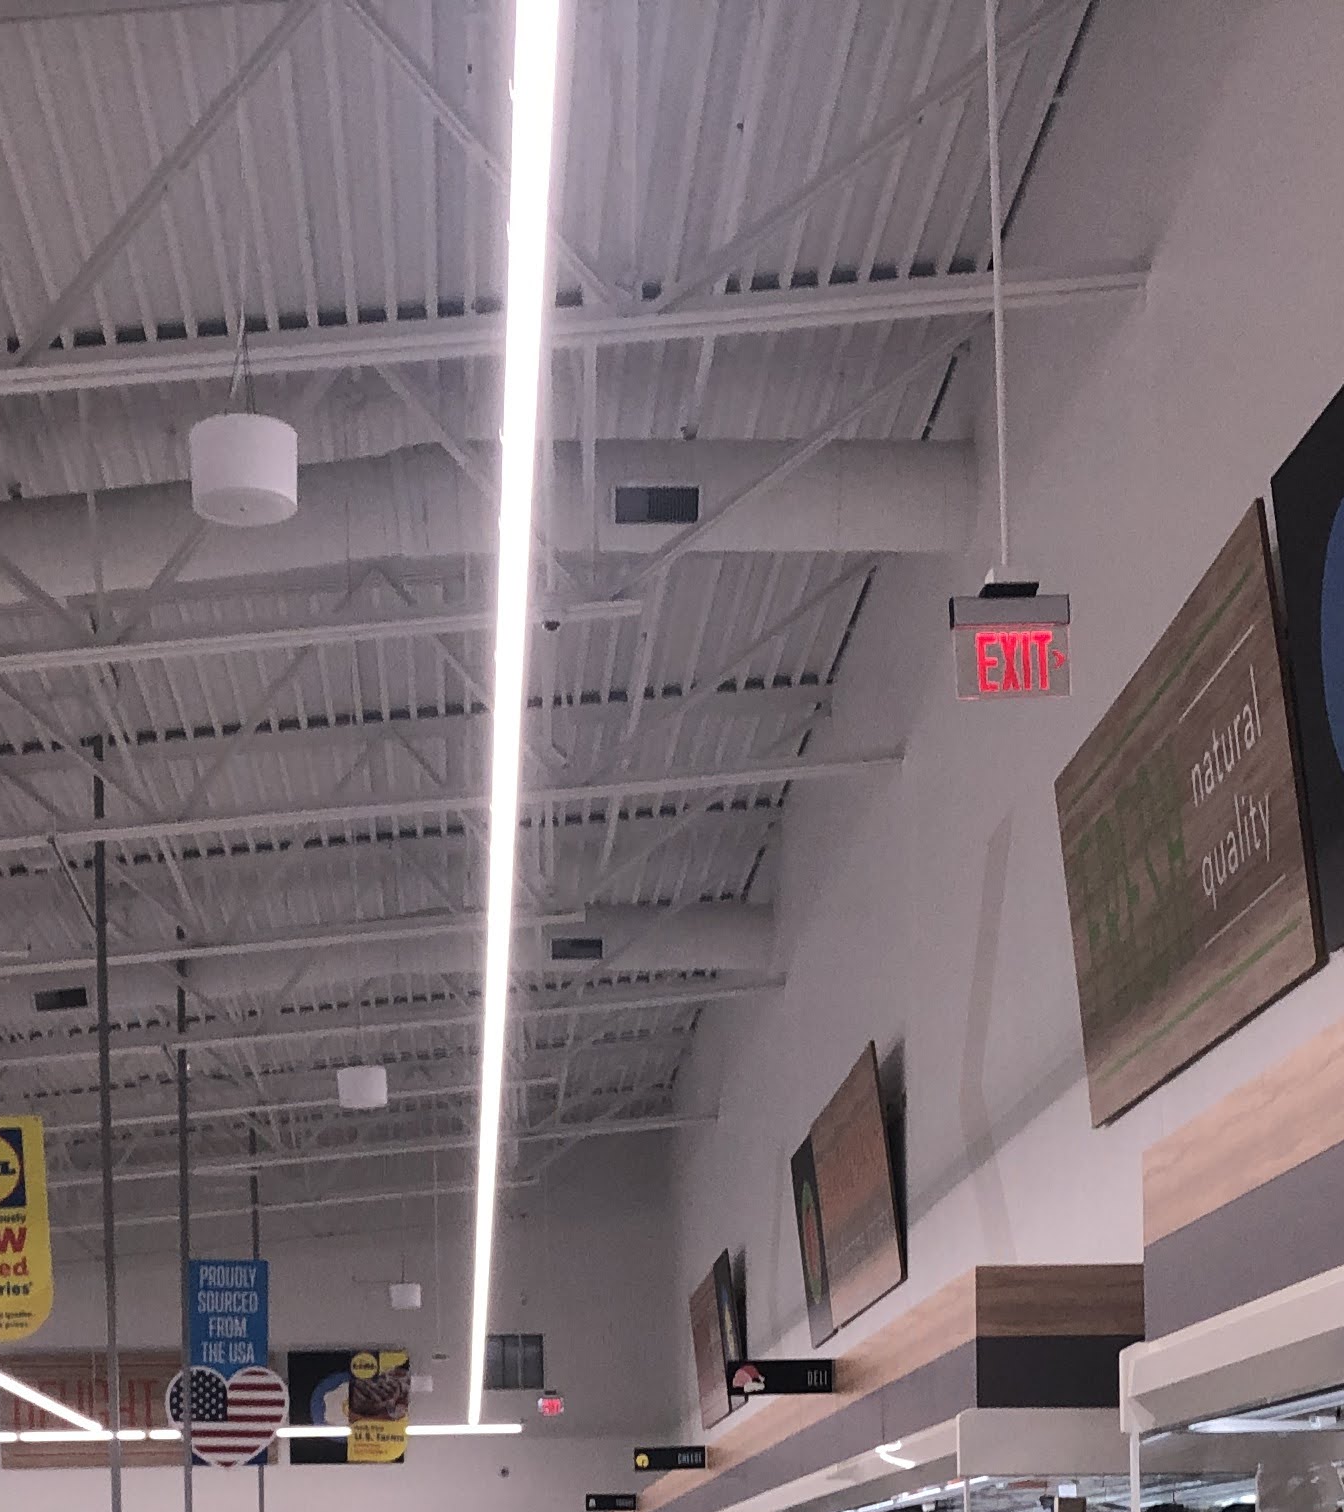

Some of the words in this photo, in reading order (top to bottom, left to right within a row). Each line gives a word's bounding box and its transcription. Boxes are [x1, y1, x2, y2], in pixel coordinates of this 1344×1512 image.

[975, 631, 1052, 692] EXIT
[1188, 664, 1262, 808] natural
[1200, 792, 1272, 910] quality
[199, 1265, 256, 1289] PROUDLY
[197, 1291, 258, 1314] SOURCED
[209, 1317, 247, 1338] FROM
[201, 1342, 227, 1362] THE
[229, 1342, 254, 1362] USA
[806, 1370, 829, 1386] DELI
